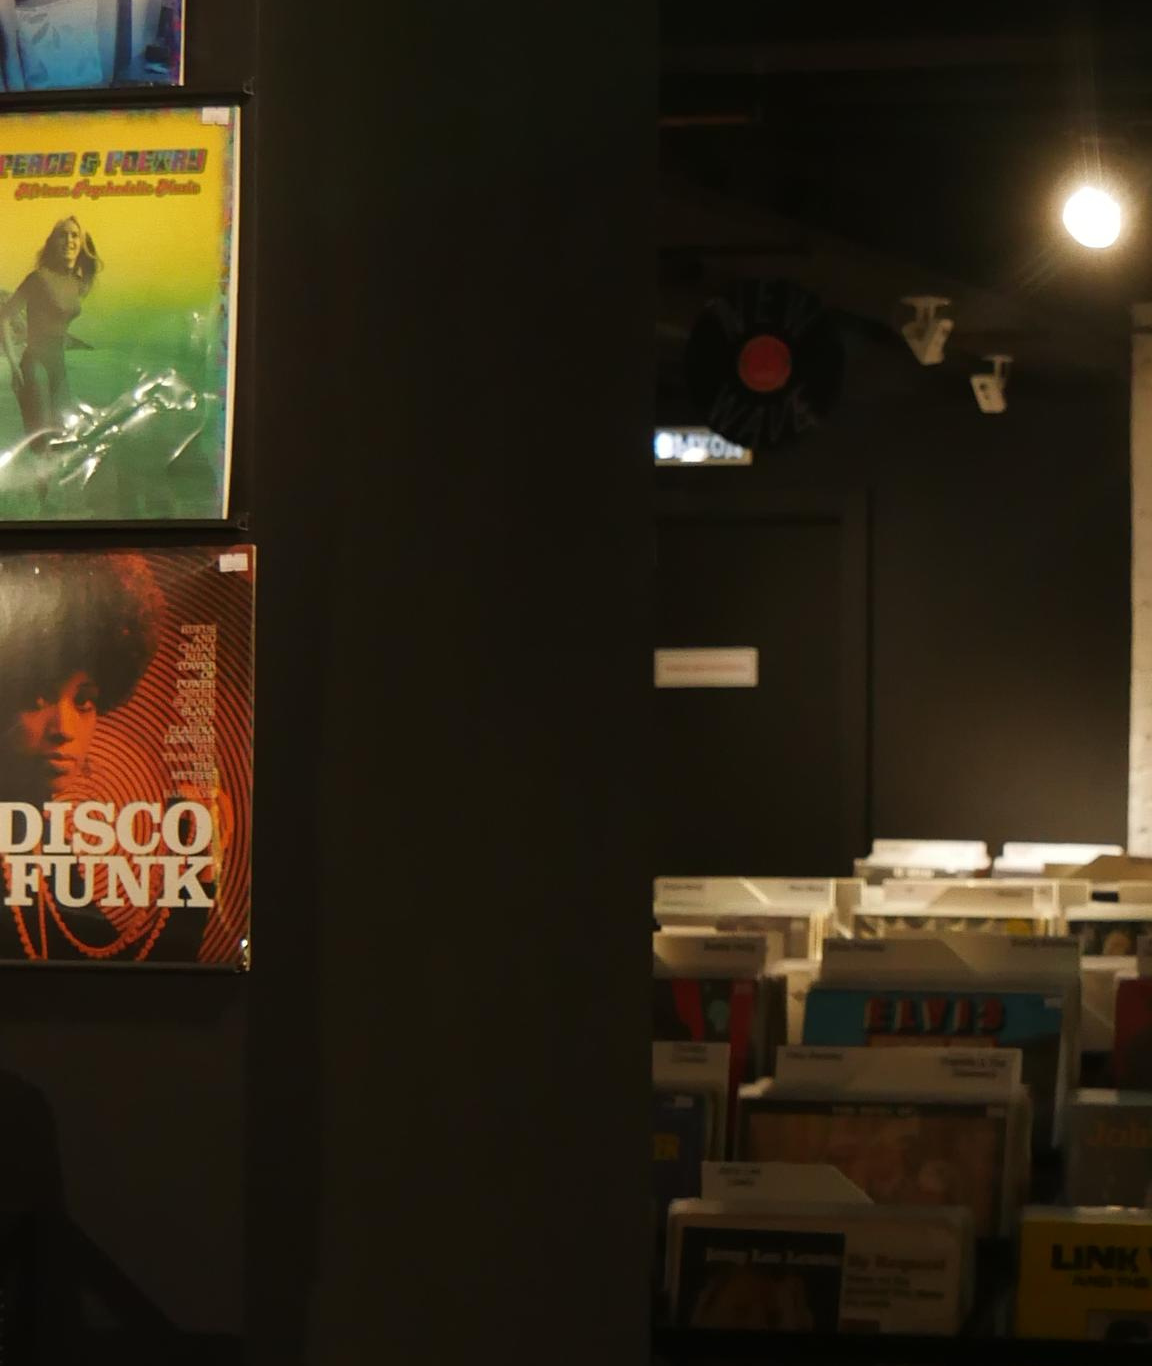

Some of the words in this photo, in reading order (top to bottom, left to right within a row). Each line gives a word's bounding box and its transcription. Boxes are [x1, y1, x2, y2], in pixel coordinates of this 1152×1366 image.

[0, 152, 76, 178] PEACE
[104, 148, 208, 176] POETRY
[71, 179, 154, 201] Psychedelic
[155, 178, 201, 197] Music
[177, 662, 216, 671] TOWER
[0, 801, 213, 854] DISCO
[3, 855, 214, 908] FUNK
[864, 997, 1004, 1034] ELVIS
[1050, 1243, 1139, 1274] LINK
